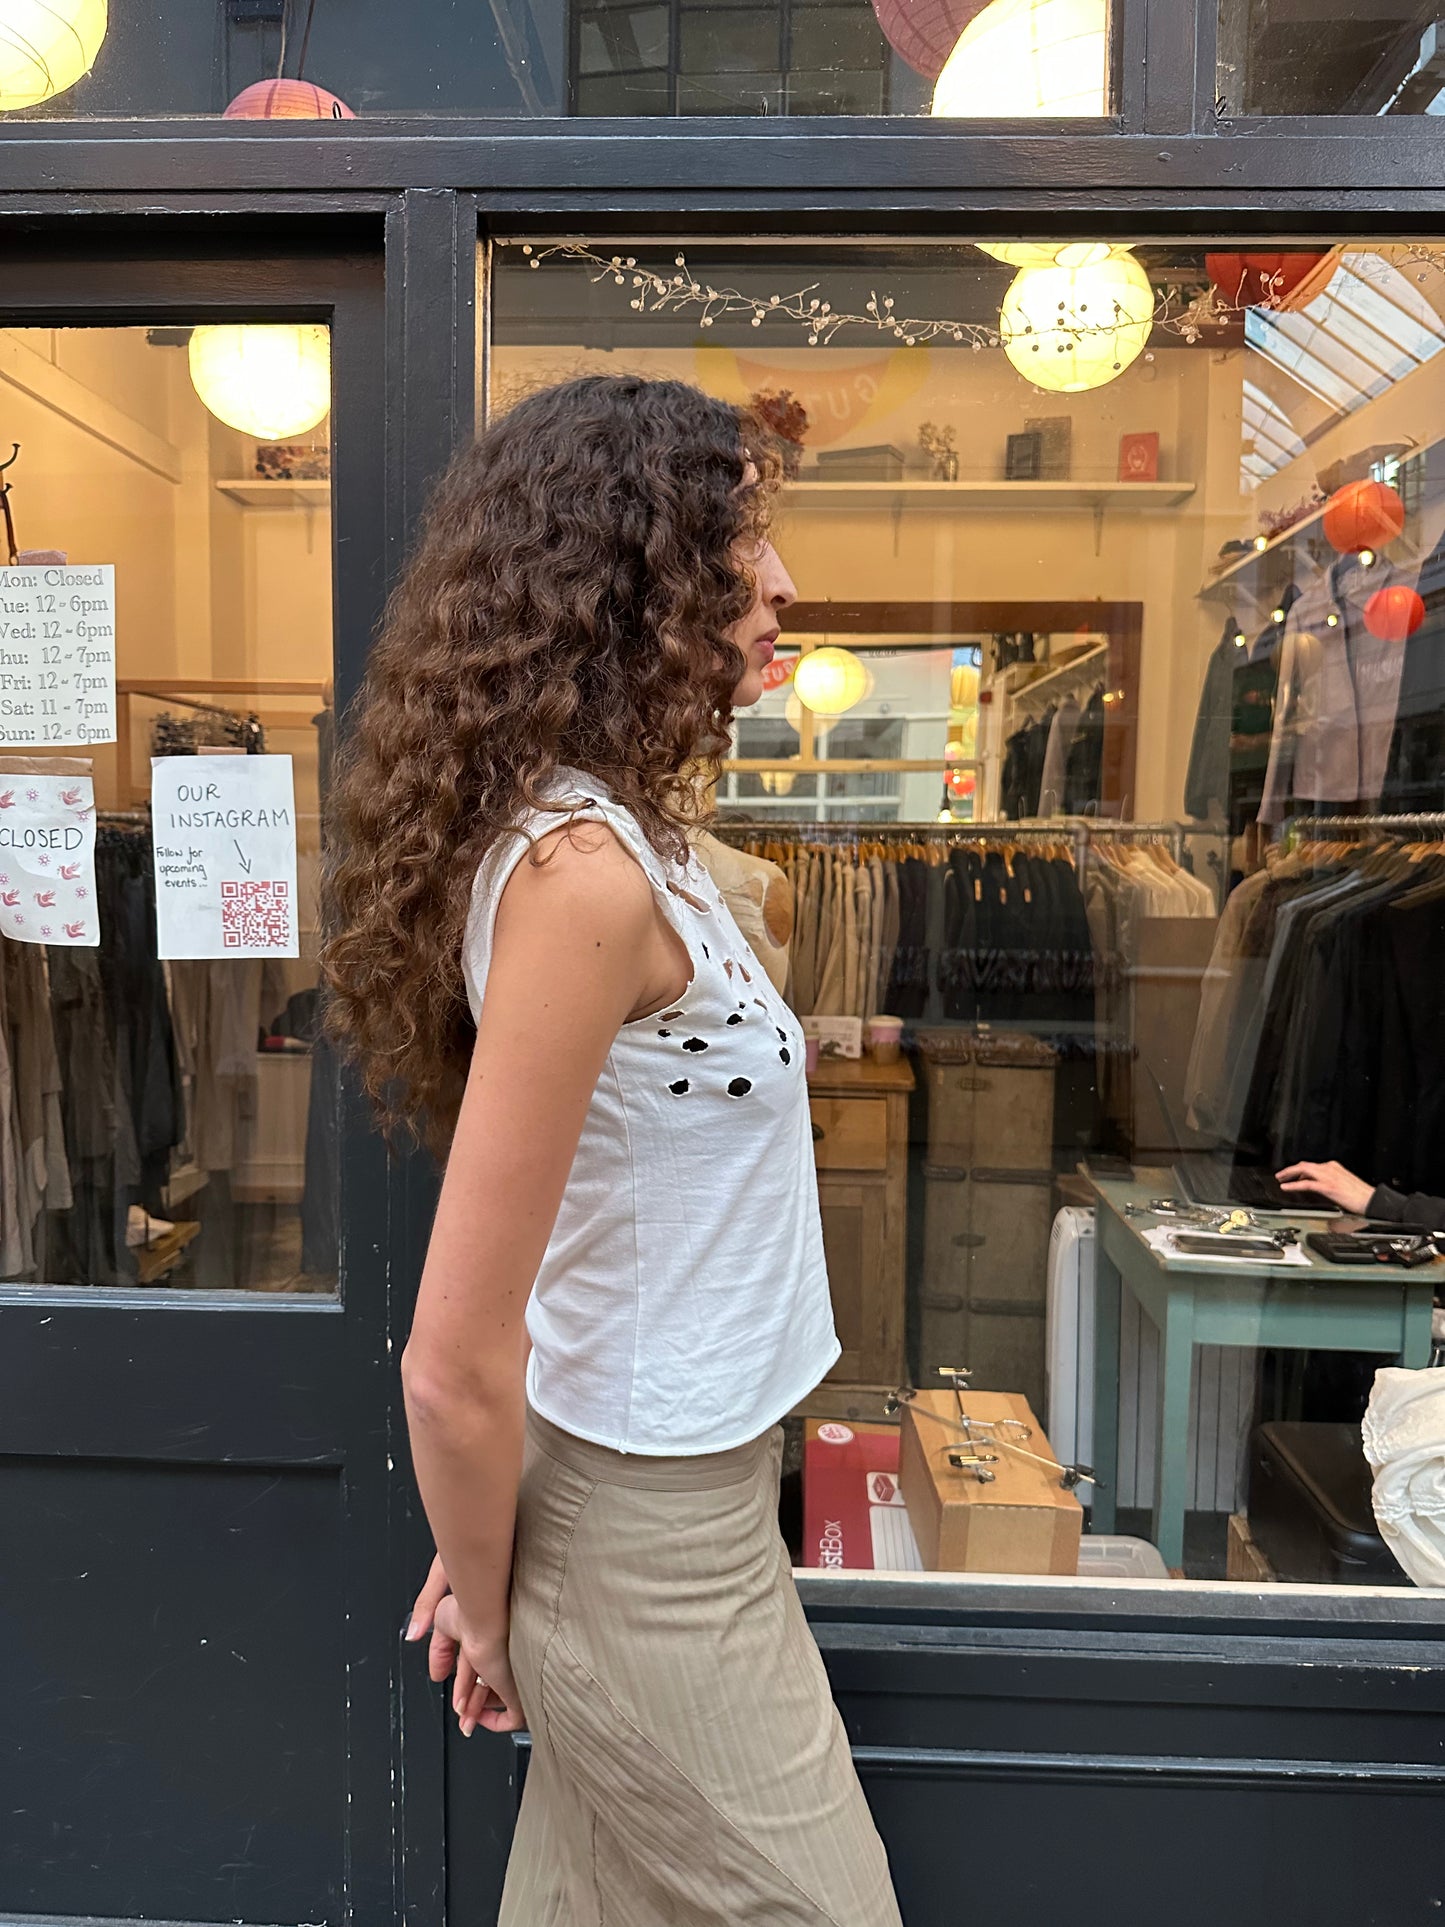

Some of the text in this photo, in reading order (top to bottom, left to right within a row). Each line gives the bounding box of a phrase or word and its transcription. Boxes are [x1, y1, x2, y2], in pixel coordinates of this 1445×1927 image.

[44, 569, 104, 587] Closed
[0, 648, 28, 665] hu:
[0, 674, 31, 690] Fri:
[1, 699, 34, 715] Sat:
[0, 724, 35, 741] Sun:
[177, 783, 221, 802] OUR
[171, 808, 290, 829] INSTAGRAM
[0, 827, 83, 850] CLOSED
[155, 846, 204, 865] Follow for
[159, 864, 208, 880] upcoming
